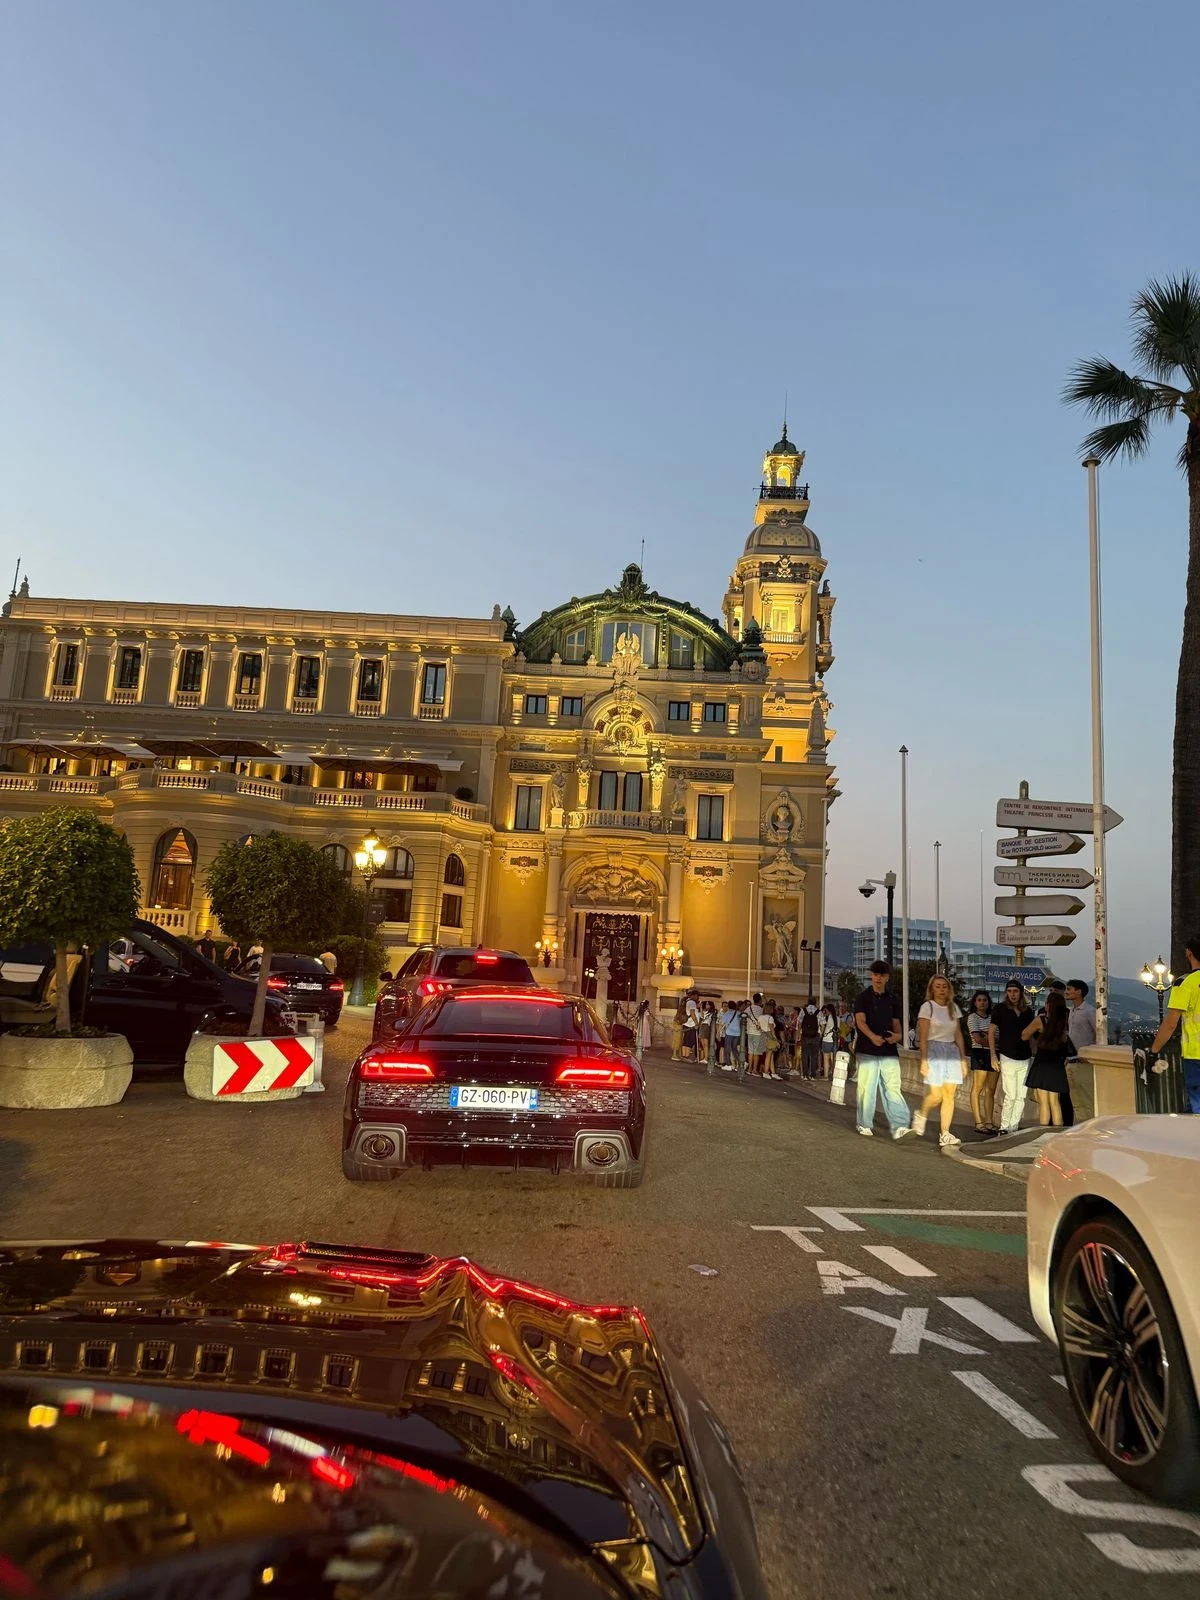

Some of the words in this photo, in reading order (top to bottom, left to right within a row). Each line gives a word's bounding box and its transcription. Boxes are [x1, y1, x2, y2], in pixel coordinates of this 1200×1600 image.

[1001, 840, 1022, 848] BANQUE
[1034, 836, 1058, 845] GESTION
[1011, 846, 1045, 854] ROTHSCHILD
[988, 970, 1010, 979] HAVAS
[1010, 971, 1042, 981] VOYAGES
